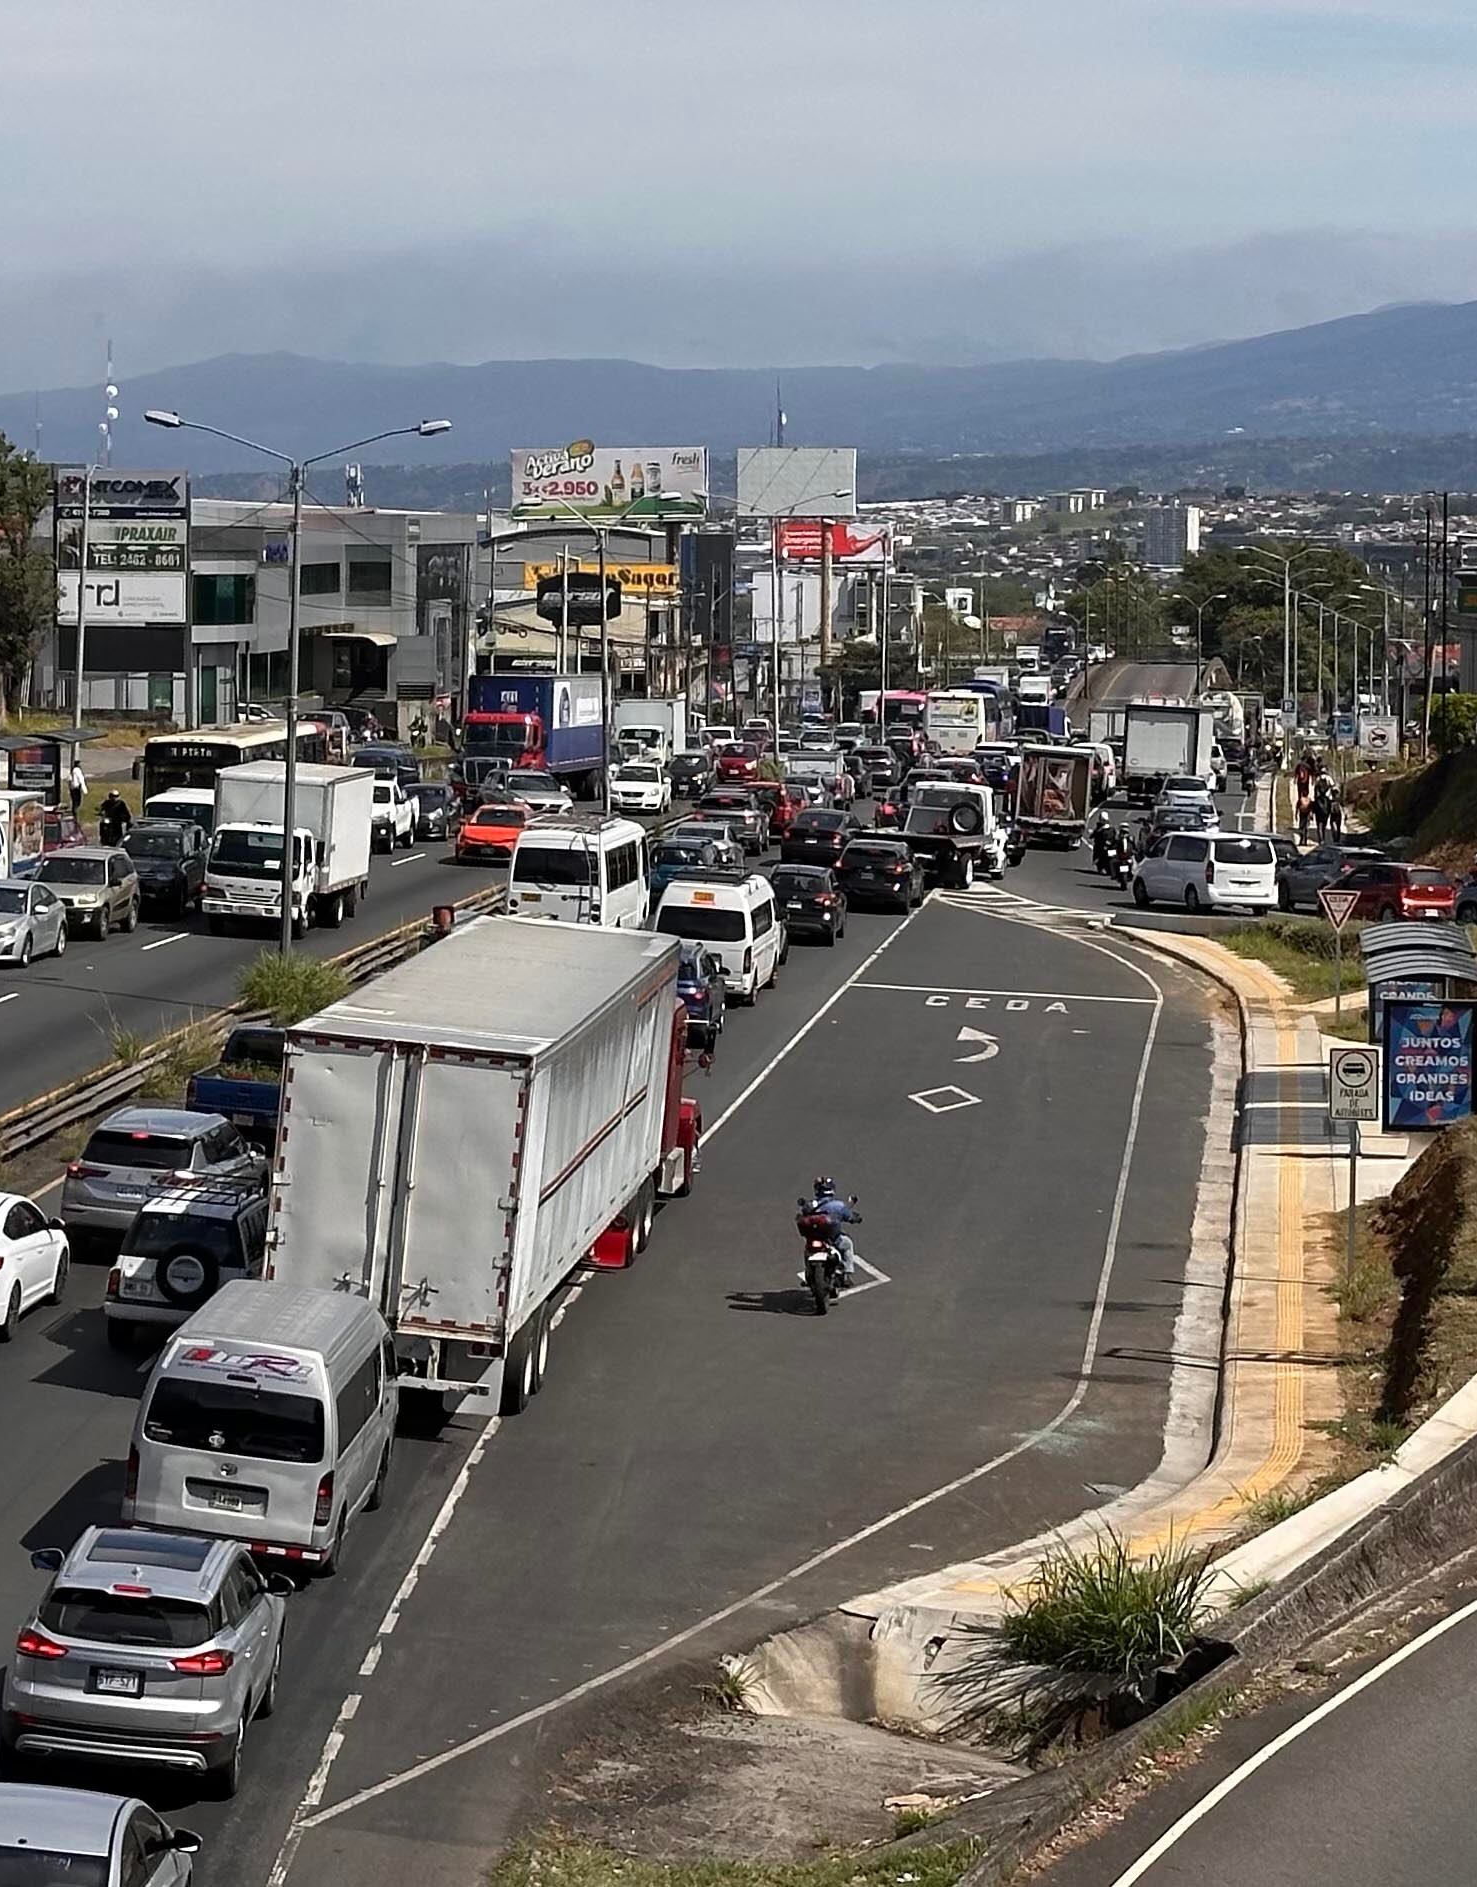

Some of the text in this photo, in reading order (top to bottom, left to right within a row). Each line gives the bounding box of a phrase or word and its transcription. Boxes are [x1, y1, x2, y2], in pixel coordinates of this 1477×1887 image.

[526, 450, 570, 475] Activa
[671, 452, 700, 465] fresh
[532, 453, 594, 480] Verano
[120, 526, 178, 541] PRAXAIR
[92, 553, 117, 566] TEL:
[1402, 1037, 1461, 1048] JUNTOS
[1394, 1055, 1469, 1067] CREAMOS
[1396, 1073, 1468, 1085] GRANDES
[1409, 1090, 1455, 1102] IDEAS
